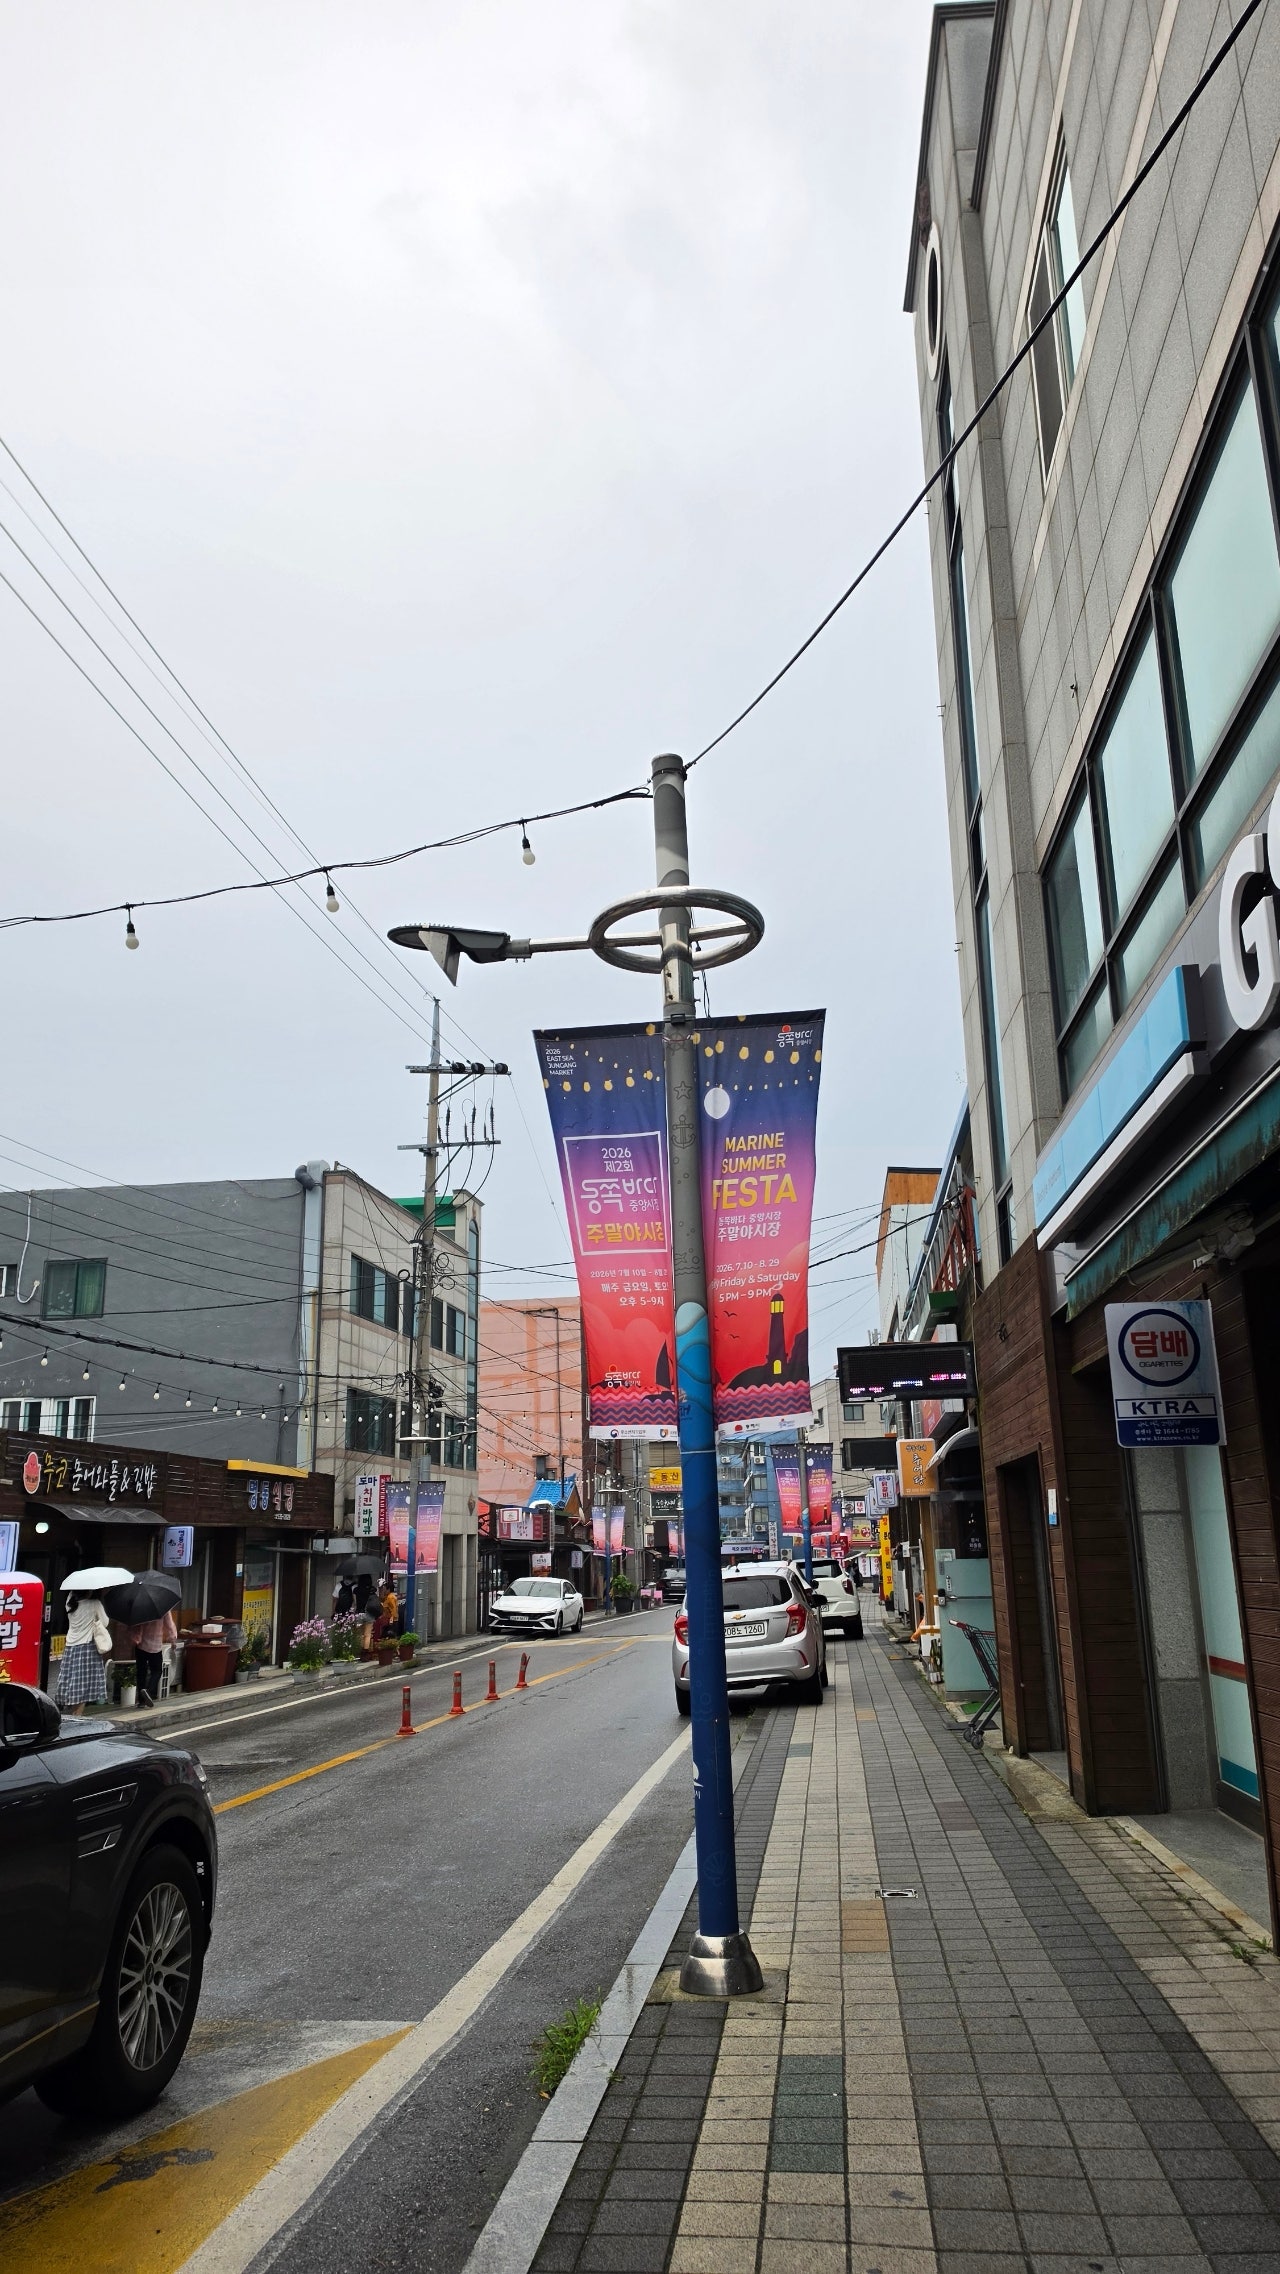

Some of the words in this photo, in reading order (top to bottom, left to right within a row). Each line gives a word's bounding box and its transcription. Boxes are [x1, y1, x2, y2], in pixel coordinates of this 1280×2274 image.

[725, 1132, 785, 1152] MARINE
[601, 1147, 631, 1159] 2026
[604, 1160, 634, 1172] 제2회
[722, 1153, 787, 1174] SUMMER
[581, 1177, 657, 1214] 동쪽바다
[712, 1173, 798, 1210] FESTA
[718, 1215, 746, 1226] 동쪽바다
[749, 1211, 782, 1223] 중앙시장
[718, 1221, 782, 1243] 주말야시장
[590, 1270, 616, 1278] 2026년
[618, 1269, 630, 1277] 7월
[632, 1268, 647, 1277] 10일
[716, 1263, 734, 1273] 2026.
[769, 1259, 780, 1267] 29
[720, 1277, 746, 1287] Friday
[748, 1275, 756, 1284] &
[757, 1271, 800, 1283] Saturday
[601, 1283, 619, 1293] 매주
[719, 1294, 724, 1303] 5
[725, 1292, 739, 1301] PM
[747, 1289, 754, 1298] 9
[756, 1288, 772, 1298] PM
[620, 1296, 637, 1306] 오후
[640, 1296, 664, 1306] 5-9시
[1130, 1330, 1189, 1358] 담배
[1131, 1400, 1200, 1415] KTRA
[912, 1453, 927, 1485] 추어탕
[358, 1476, 378, 1486] 도마
[248, 1480, 295, 1511] 명동식당
[363, 1487, 373, 1506] 치킨
[362, 1508, 373, 1534] 바베큐
[743, 1625, 763, 1635] 1260
